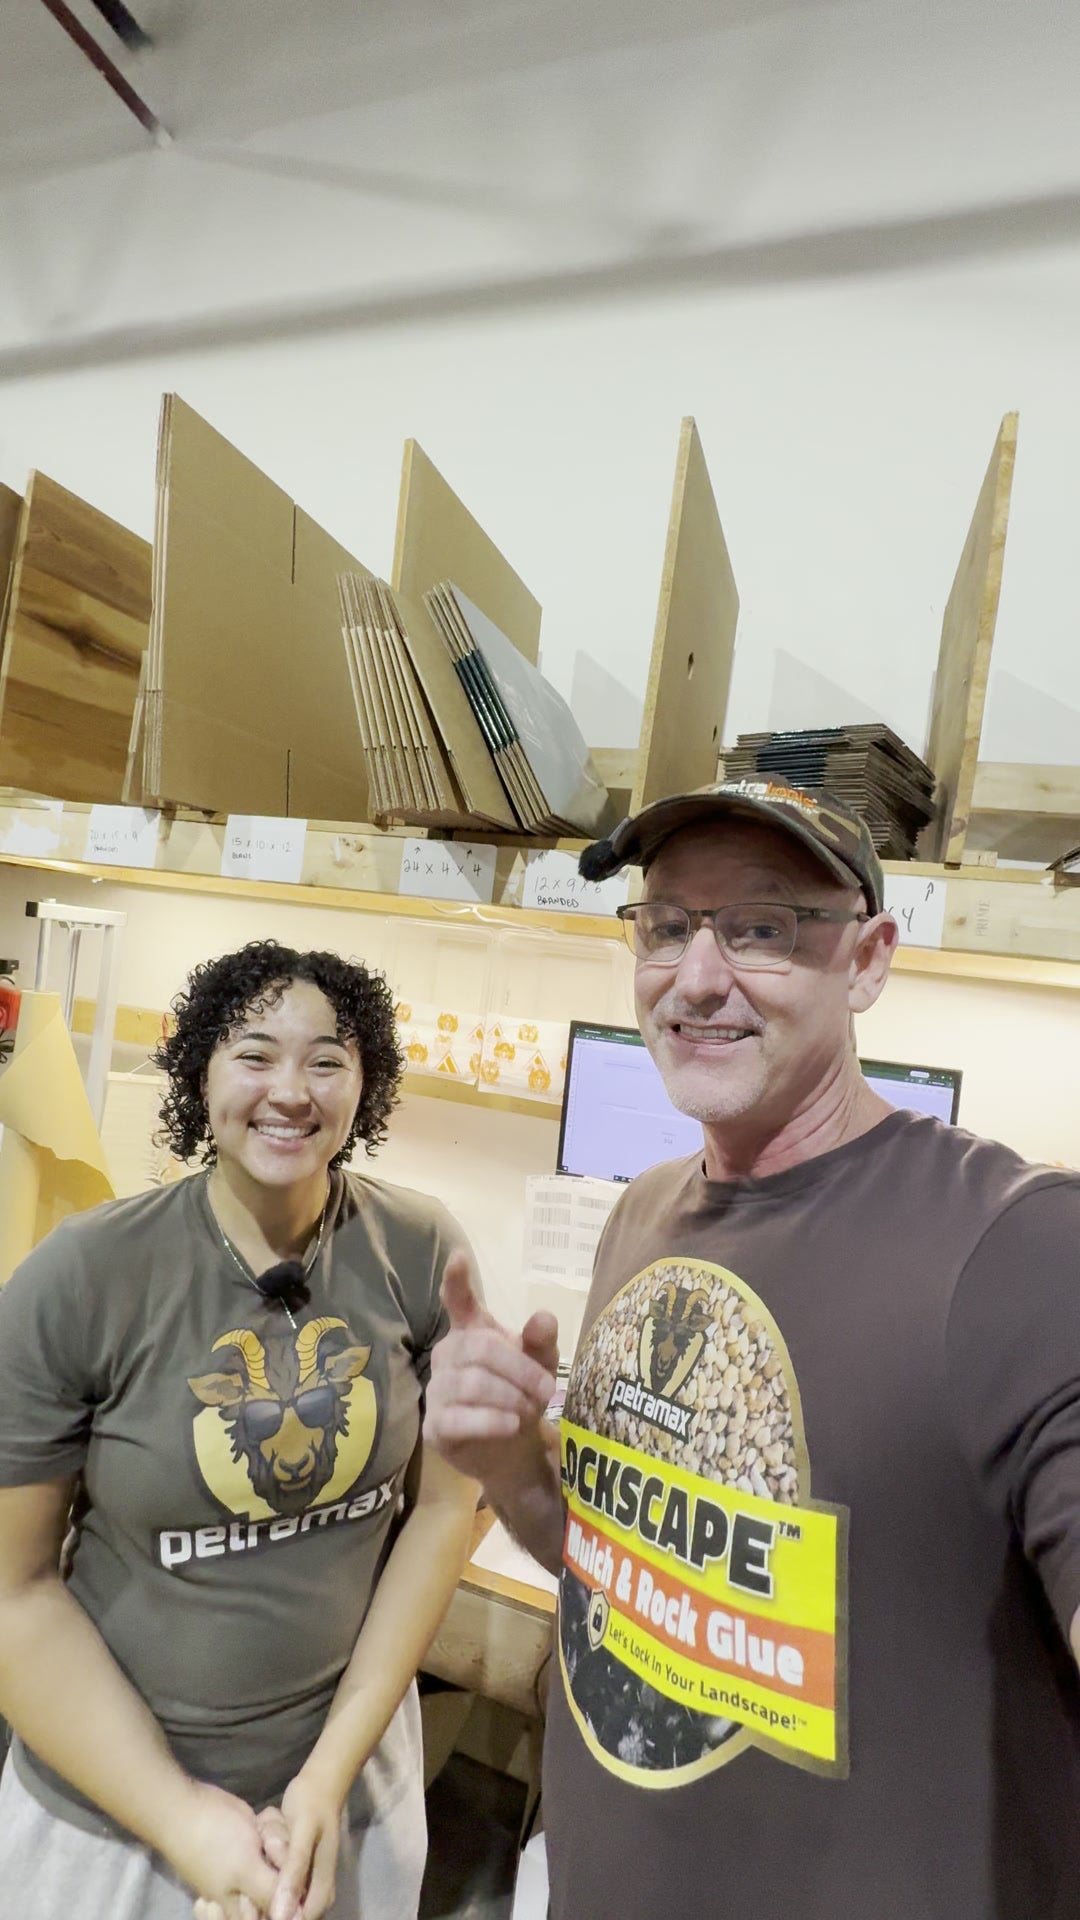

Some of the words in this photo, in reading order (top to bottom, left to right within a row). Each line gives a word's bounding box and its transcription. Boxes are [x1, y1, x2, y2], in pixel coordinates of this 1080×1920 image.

[231, 837, 242, 846] 15
[256, 840, 266, 850] 10
[403, 859, 420, 873] 24
[442, 862, 451, 875] 4
[473, 864, 482, 877] 4
[534, 876, 550, 893] 12
[566, 877, 577, 893] 9
[595, 881, 602, 894] 6
[537, 895, 580, 908] BRANDED
[902, 907, 915, 933] 4
[610, 1379, 692, 1437] petramax
[567, 1520, 614, 1590] Mulch
[615, 1557, 632, 1604] &
[635, 1568, 698, 1648] Rock
[706, 1600, 804, 1687] Glue
[609, 1622, 628, 1649] Let's
[630, 1638, 650, 1665] Lock
[665, 1663, 695, 1692] Your
